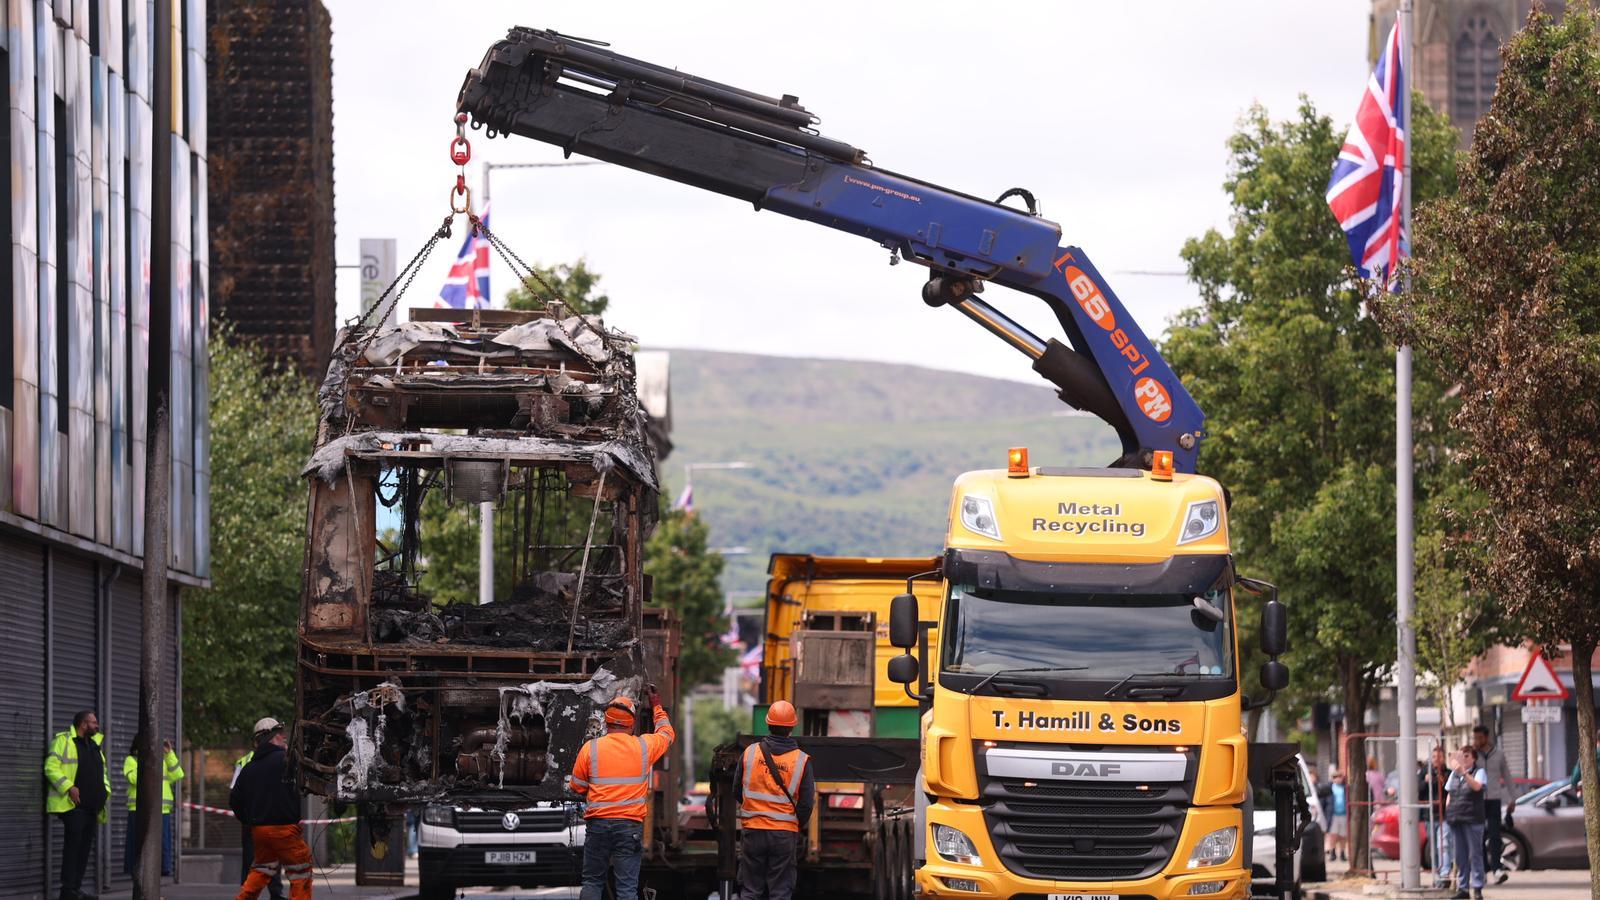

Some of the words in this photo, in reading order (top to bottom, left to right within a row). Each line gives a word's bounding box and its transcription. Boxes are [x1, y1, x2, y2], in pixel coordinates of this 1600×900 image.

[1134, 378, 1172, 420] PM
[1058, 502, 1120, 516] Metal
[1032, 518, 1146, 537] Recycling
[992, 710, 1010, 729] T.
[1018, 711, 1091, 731] Hamill
[1098, 713, 1115, 732] &
[1123, 713, 1182, 734] Sons
[1051, 762, 1121, 777] DAF
